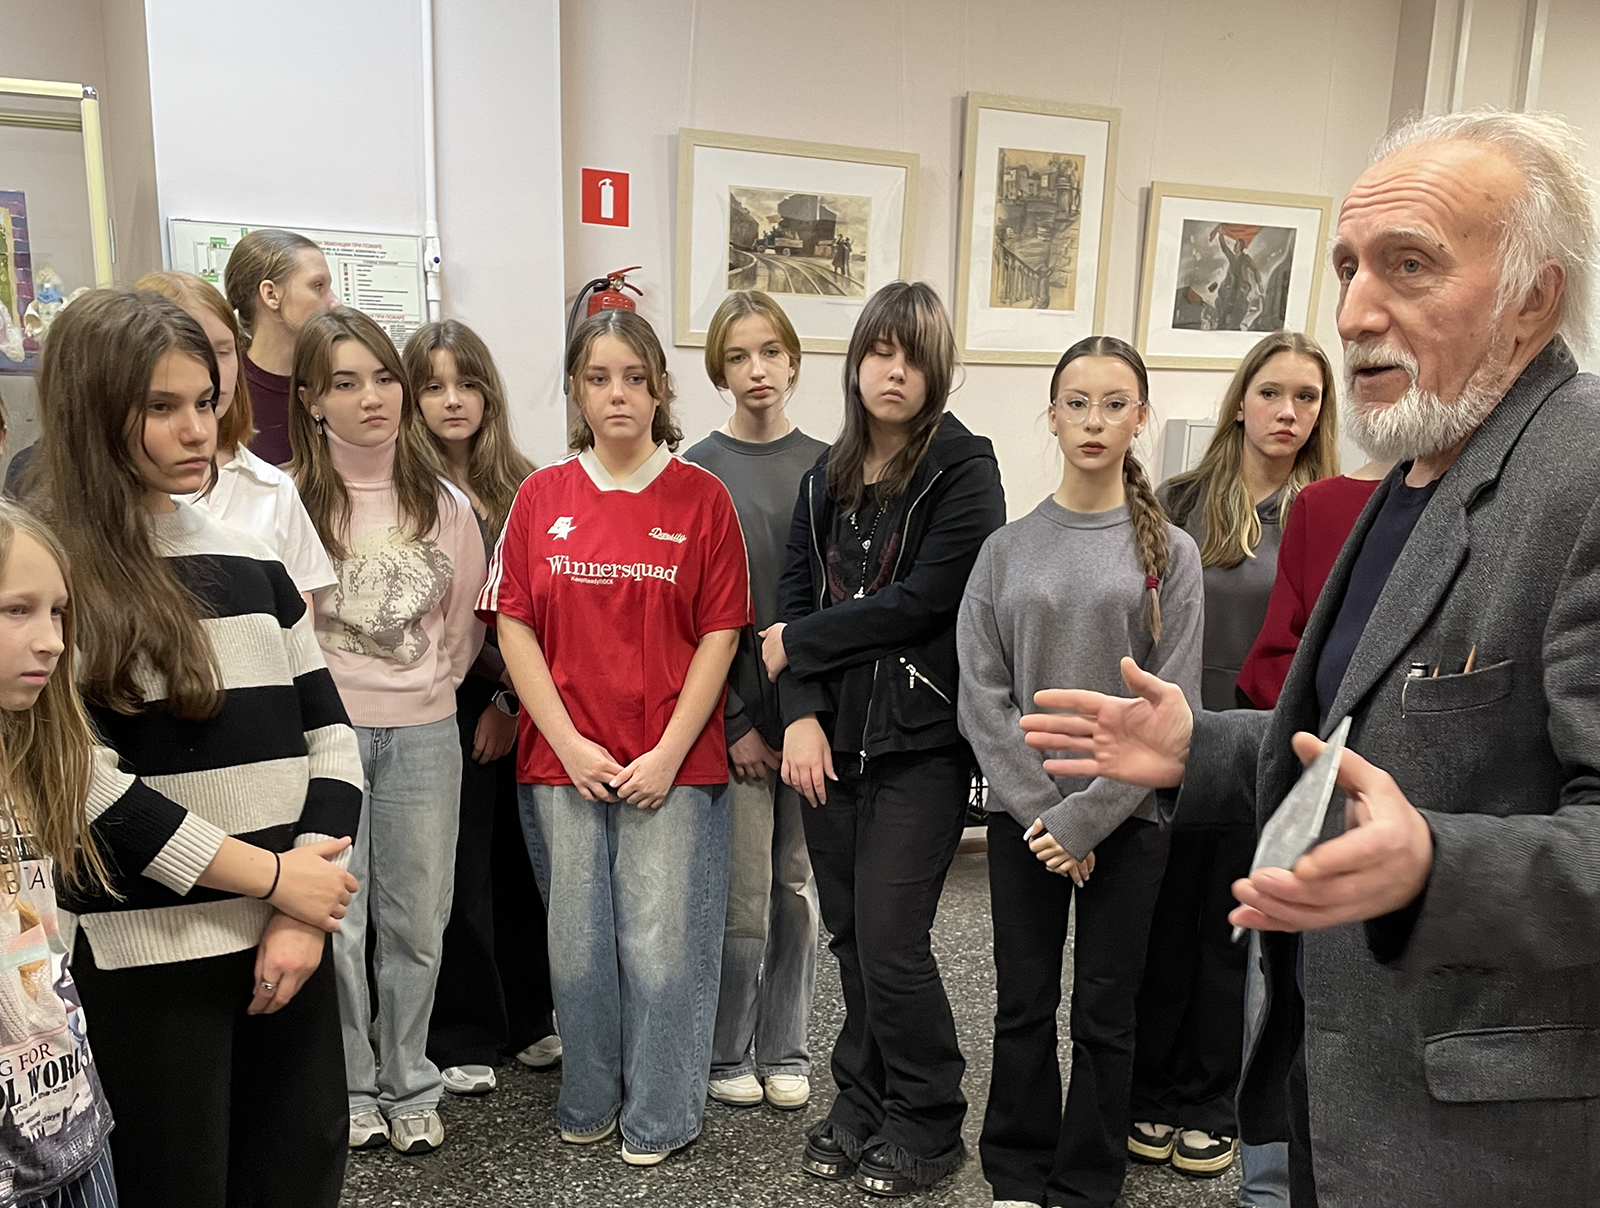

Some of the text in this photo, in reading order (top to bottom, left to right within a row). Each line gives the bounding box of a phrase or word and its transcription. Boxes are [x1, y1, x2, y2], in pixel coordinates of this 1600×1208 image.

[546, 555, 678, 585] Winnersquad
[19, 1043, 54, 1072] FOR
[14, 1103, 28, 1116] you
[52, 1084, 68, 1094] one
[42, 1112, 61, 1123] days
